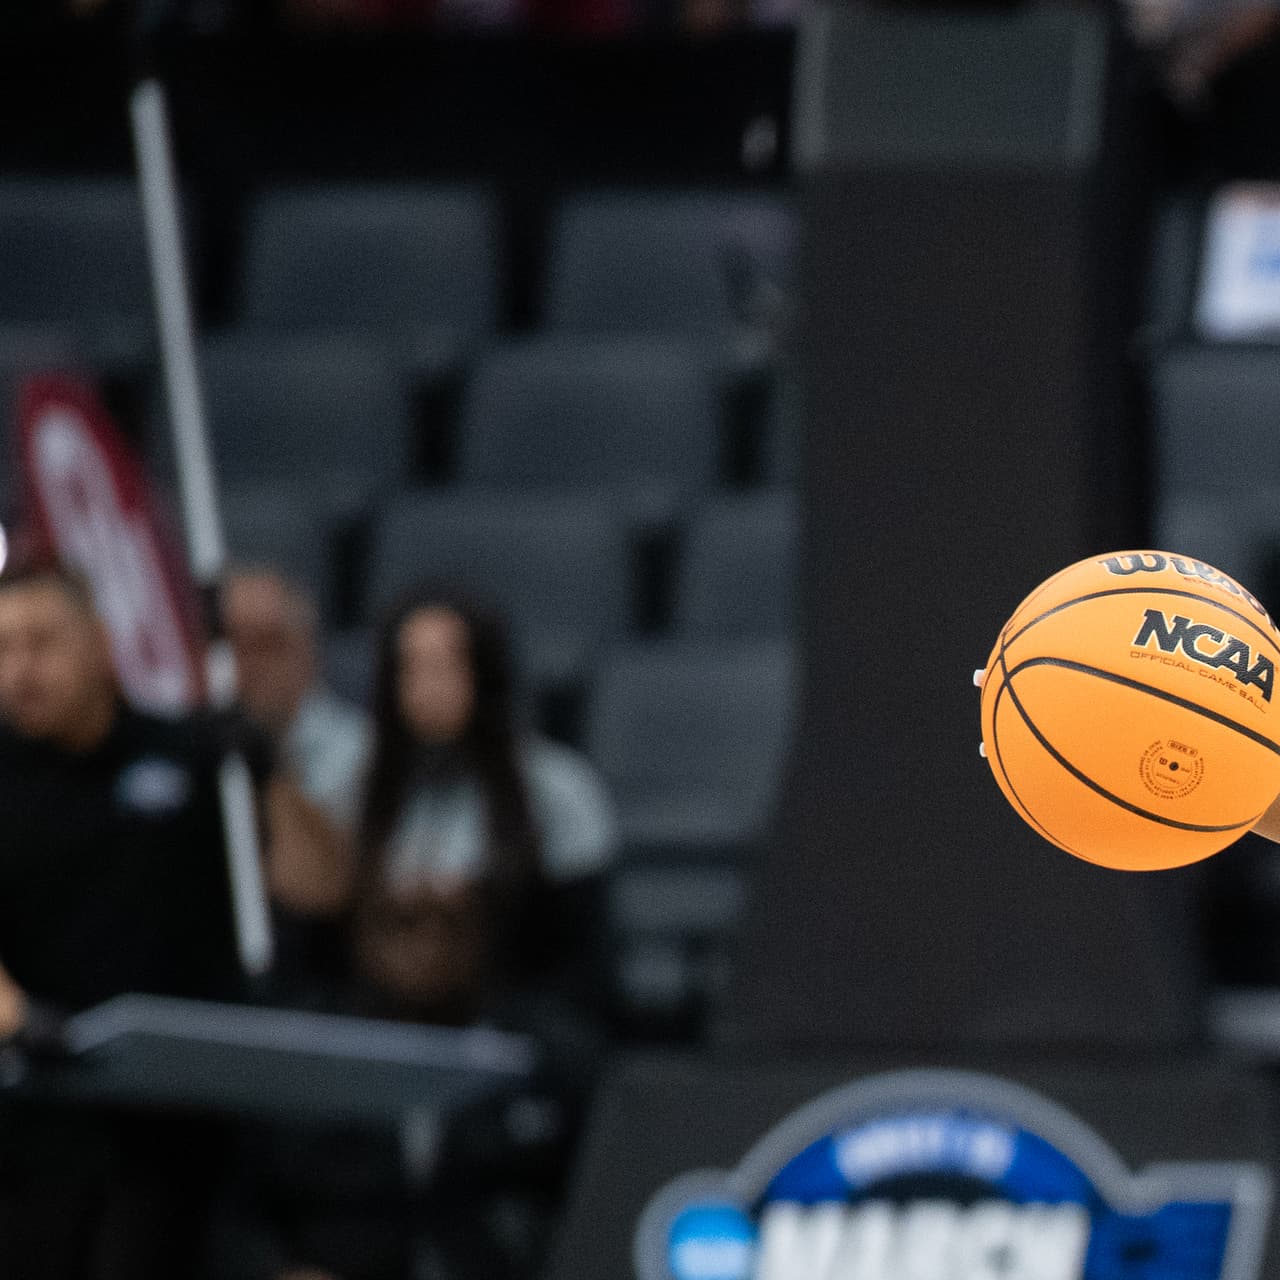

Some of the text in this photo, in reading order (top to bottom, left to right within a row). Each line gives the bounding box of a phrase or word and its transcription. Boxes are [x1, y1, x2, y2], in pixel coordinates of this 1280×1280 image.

[1130, 651, 1195, 673] OFFICIAL
[1240, 689, 1266, 714] BALL
[1131, 608, 1276, 704] NCAA
